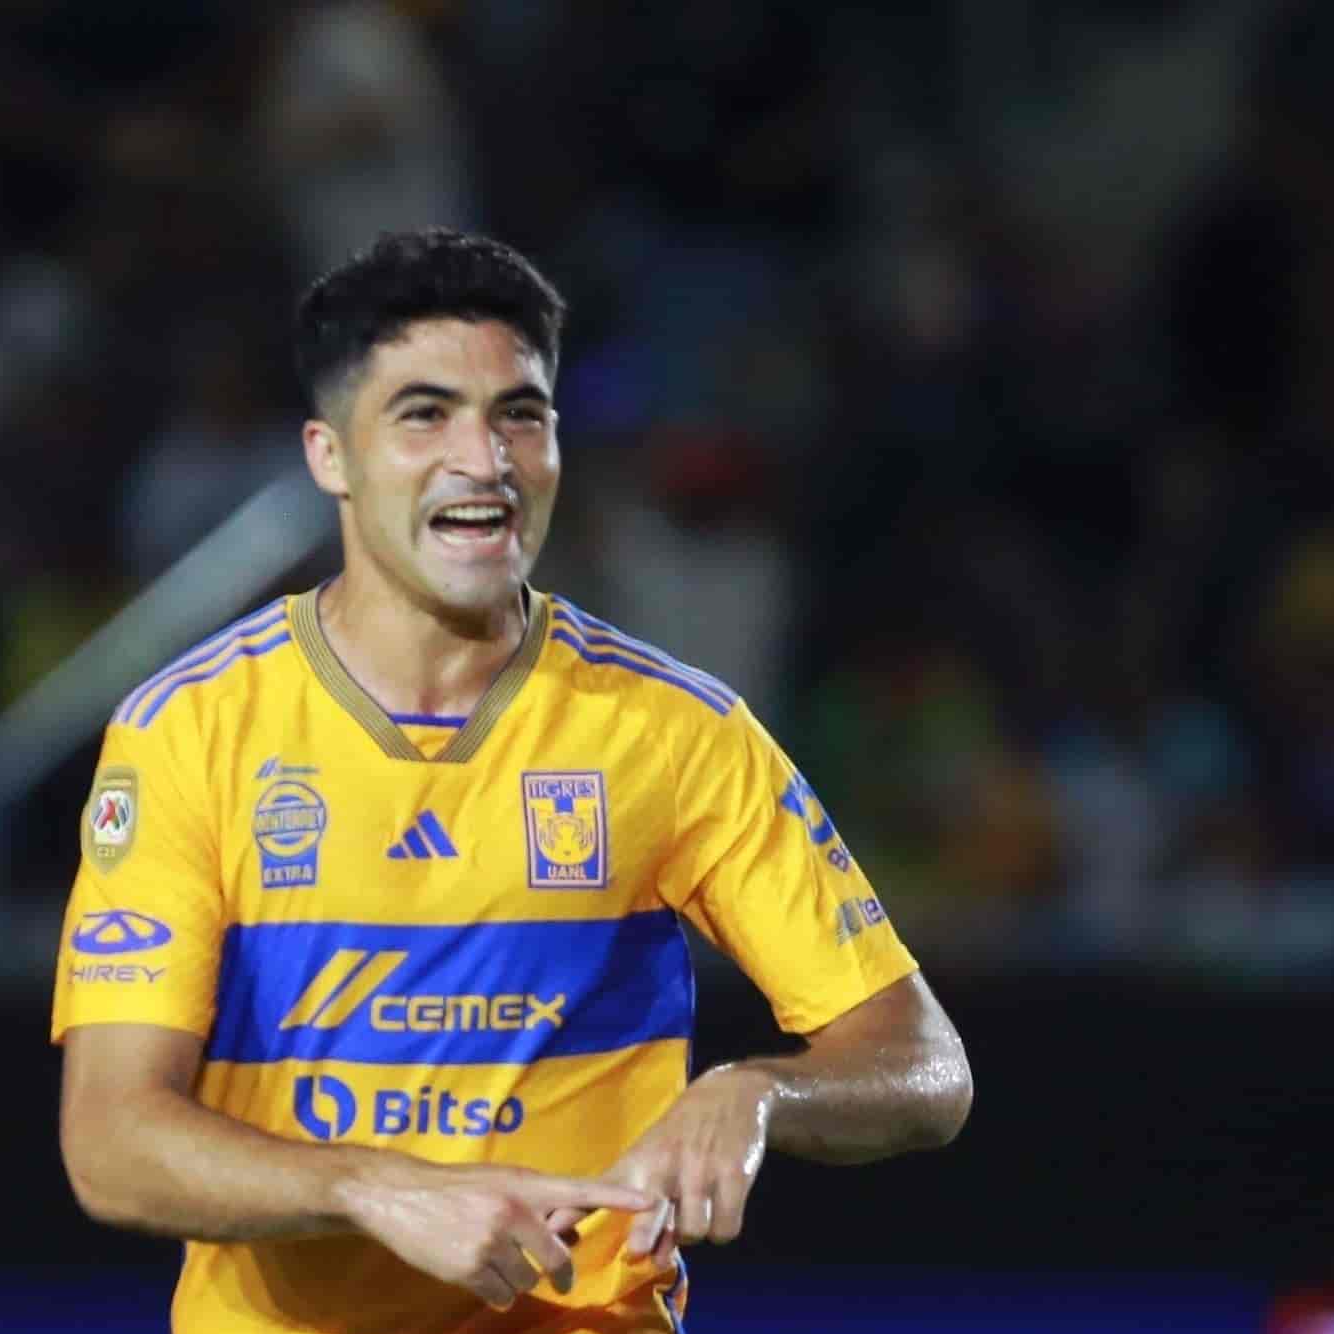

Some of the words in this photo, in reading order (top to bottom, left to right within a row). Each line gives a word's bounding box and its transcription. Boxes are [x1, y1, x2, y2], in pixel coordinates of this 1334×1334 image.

[67, 962, 168, 985] HIREY
[370, 993, 566, 1034] CEMEX
[373, 1084, 524, 1136] Bitso
